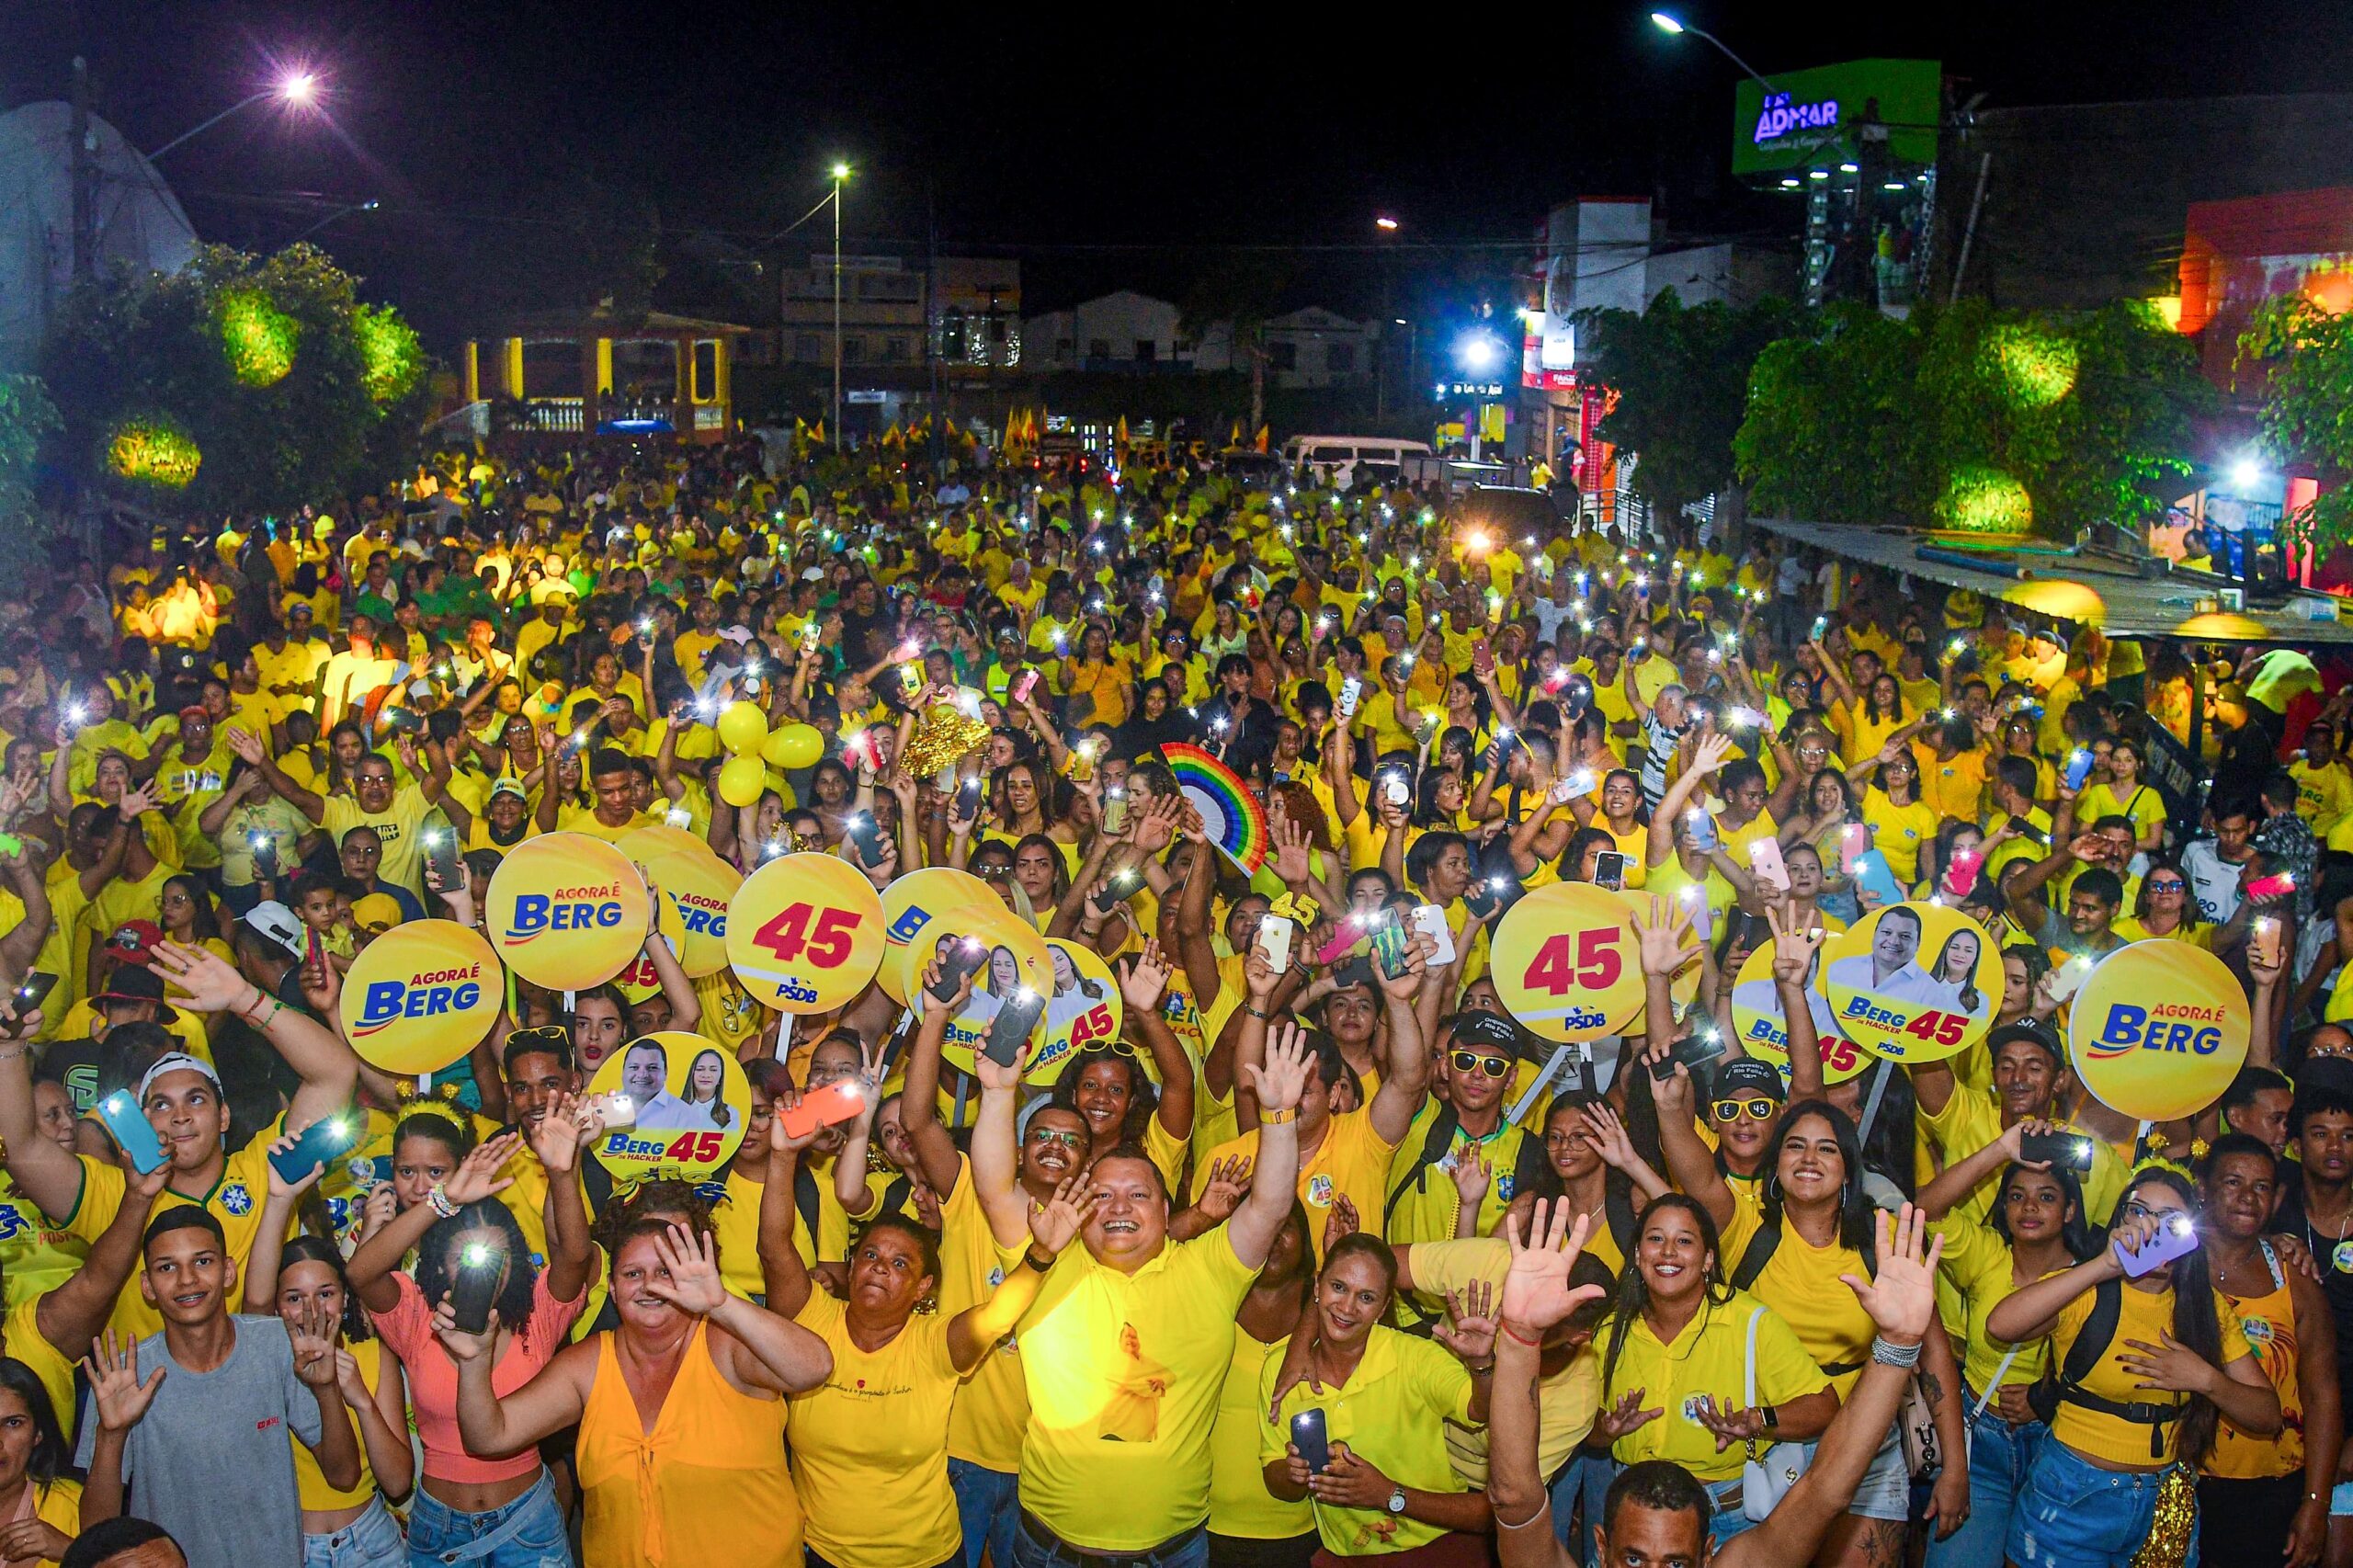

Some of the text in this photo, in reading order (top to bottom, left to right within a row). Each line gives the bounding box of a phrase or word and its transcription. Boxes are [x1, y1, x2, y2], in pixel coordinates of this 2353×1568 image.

[553, 881, 621, 900] AGORA É
[513, 893, 623, 930] BERG
[680, 892, 727, 913] AGORA
[1269, 891, 1320, 927] 45
[752, 902, 862, 969] 45
[1523, 926, 1622, 996] 45
[409, 961, 481, 987] AGORA É
[363, 980, 480, 1020] BERG
[775, 983, 818, 1004] PSDB
[1564, 1012, 1607, 1031] PSDB
[1847, 995, 1971, 1047] BERG 45
[2151, 1003, 2225, 1022] AGORA É
[1071, 1002, 1114, 1049] 45
[1865, 1019, 1902, 1035] HACKER
[2101, 1003, 2222, 1055] BERG
[1043, 1049, 1072, 1067] HACKER
[1877, 1041, 1905, 1056] PSDB
[1753, 1103, 1766, 1115] 45
[607, 1131, 725, 1163] BERG 45
[626, 1153, 663, 1163] HACKER
[1316, 1187, 1332, 1201] 45
